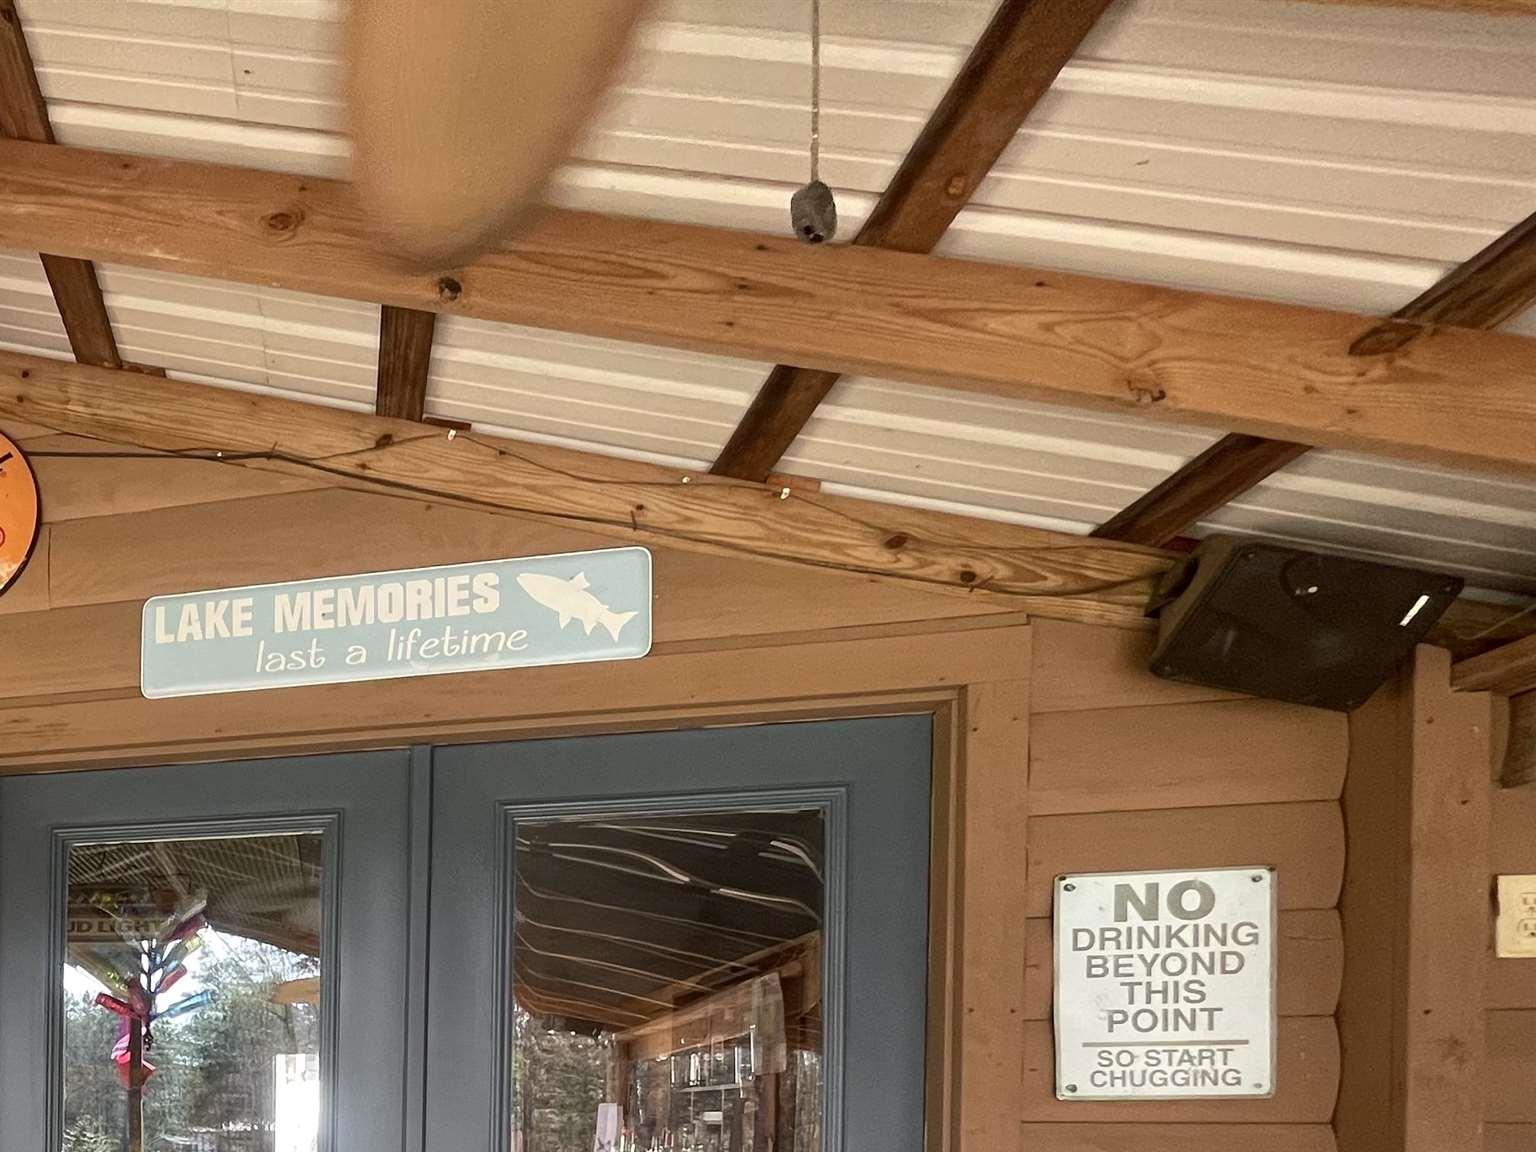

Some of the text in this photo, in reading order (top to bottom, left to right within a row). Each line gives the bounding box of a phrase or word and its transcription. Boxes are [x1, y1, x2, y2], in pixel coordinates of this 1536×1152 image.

[155, 572, 500, 645] LAKE MEMORIES
[255, 624, 529, 673] last a lifetime
[1114, 880, 1216, 922] NO
[1072, 921, 1259, 951] DRINKING
[1086, 951, 1245, 979] BEYOND
[1120, 979, 1207, 1005] THIS
[1107, 1007, 1223, 1033] POINT
[1097, 1048, 1234, 1067] SO START
[1090, 1069, 1242, 1088] CHUGGING
